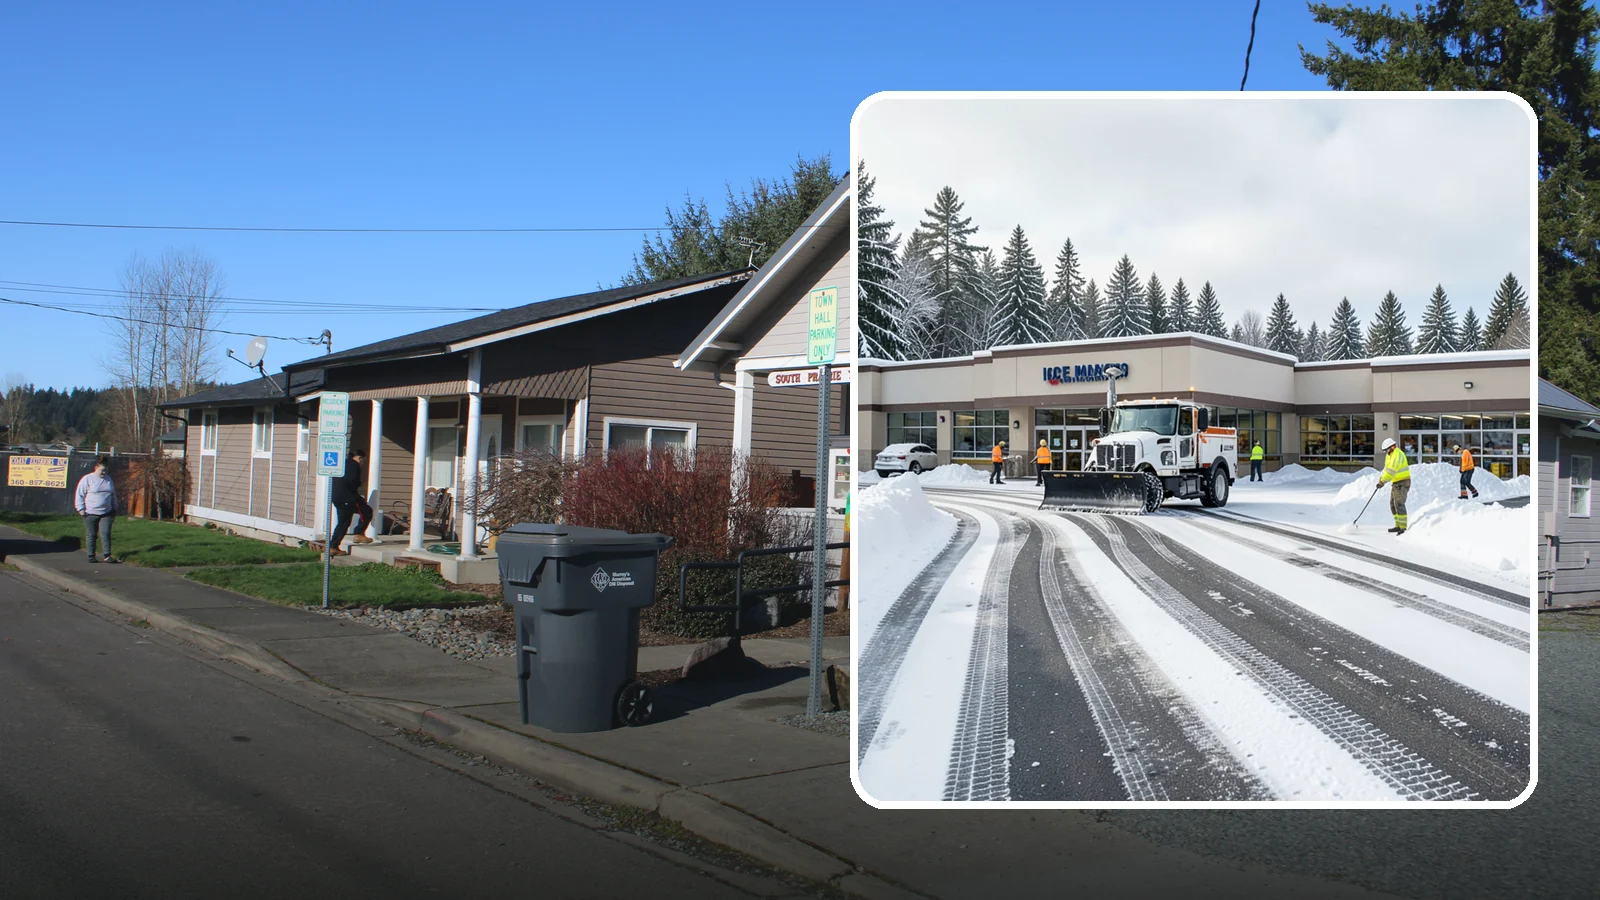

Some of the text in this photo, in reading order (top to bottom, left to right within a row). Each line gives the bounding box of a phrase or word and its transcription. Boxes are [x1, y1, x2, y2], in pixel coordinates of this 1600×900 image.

[815, 294, 833, 308] TOWN
[814, 310, 831, 324] HALL
[810, 326, 836, 341] PARKING
[813, 344, 831, 357] ONLY
[775, 373, 801, 384] SOUTH
[807, 370, 842, 383] PRIE
[323, 409, 345, 417] PARKING
[325, 420, 340, 428] ONLY
